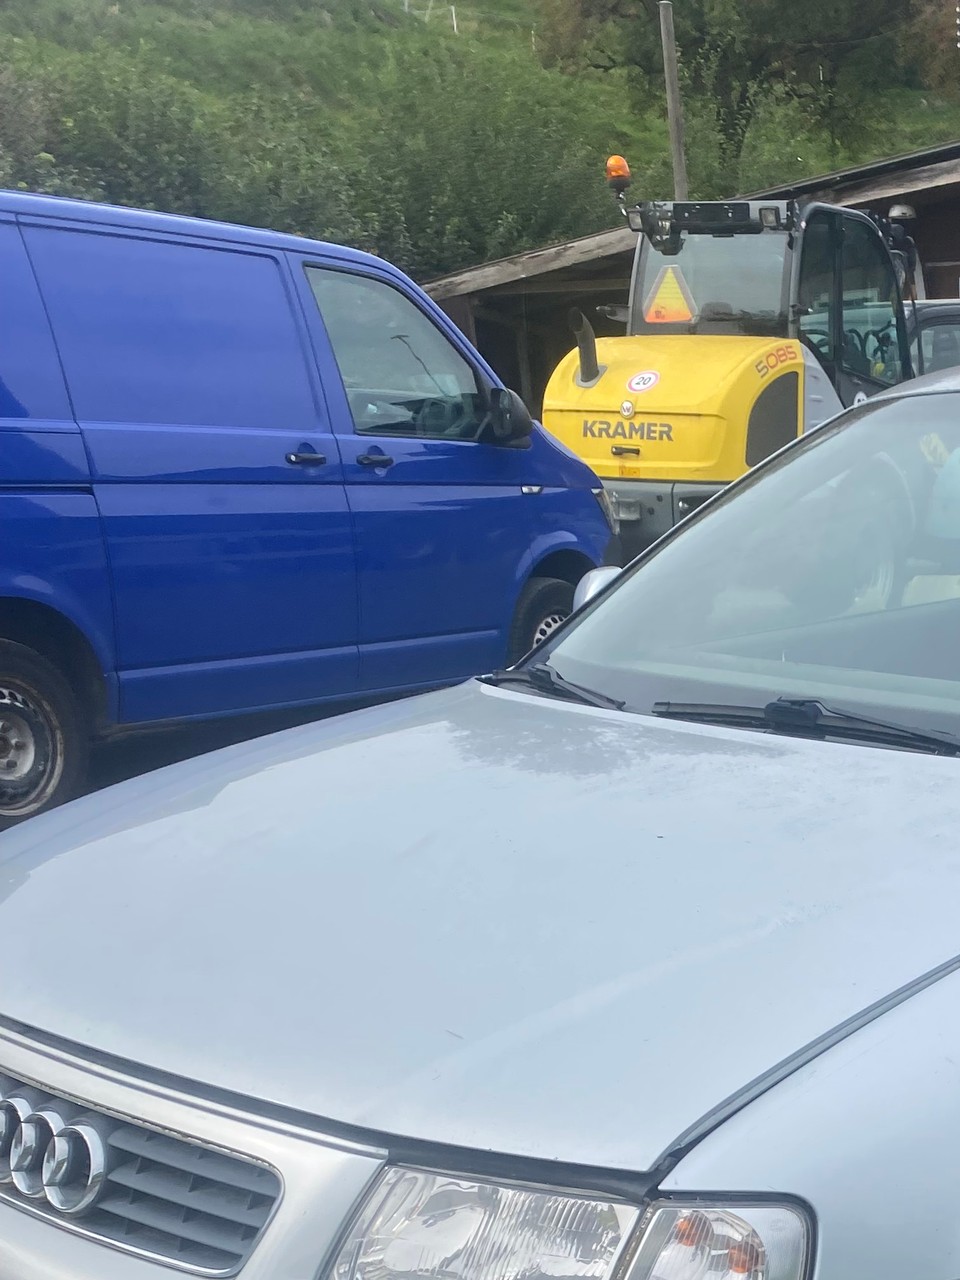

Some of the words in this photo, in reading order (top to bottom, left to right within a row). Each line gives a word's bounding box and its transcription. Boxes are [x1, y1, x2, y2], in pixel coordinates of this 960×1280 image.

[755, 346, 797, 378] 5085
[635, 377, 651, 386] 20
[582, 420, 673, 441] KRAMER
